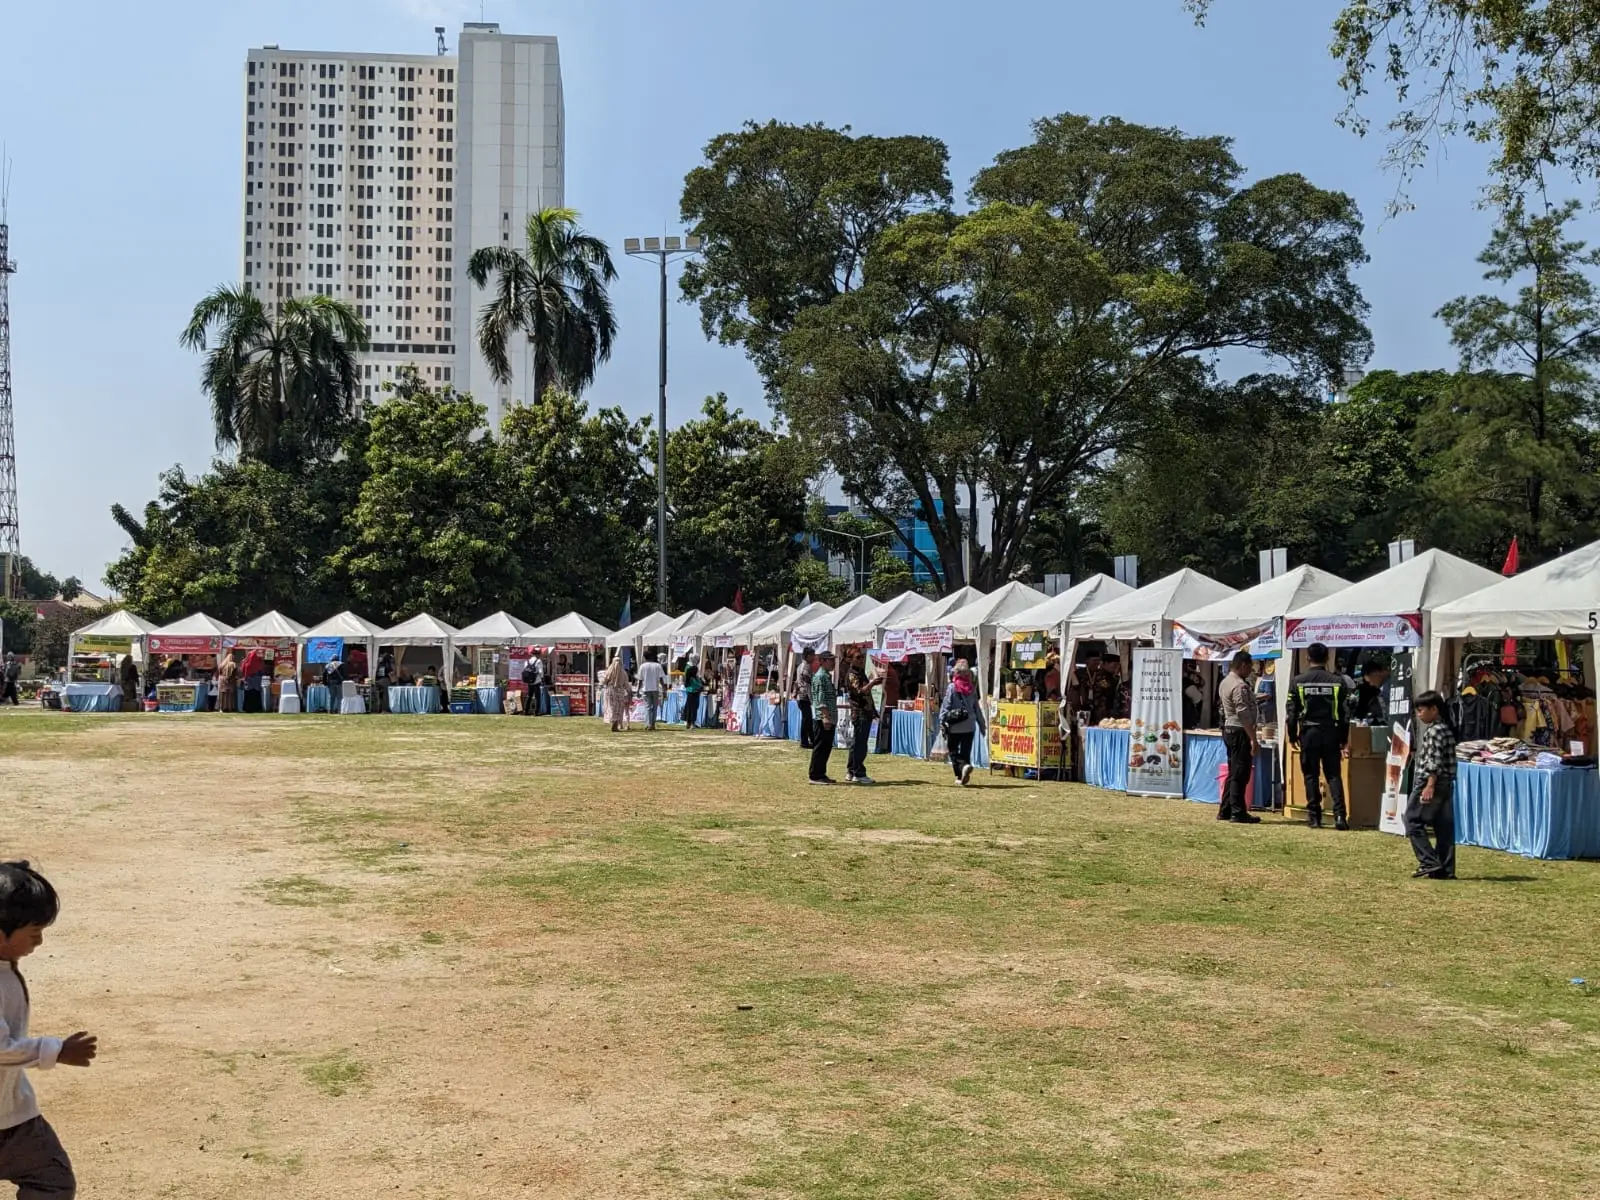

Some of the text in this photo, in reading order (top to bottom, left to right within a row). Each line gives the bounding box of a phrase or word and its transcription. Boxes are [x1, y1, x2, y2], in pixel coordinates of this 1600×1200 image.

[1151, 623, 1158, 636] 8
[1379, 621, 1395, 629] Putih
[1588, 611, 1598, 630] 5
[1007, 713, 1026, 733] LAKSA
[1000, 734, 1014, 753] TOGE
[1013, 735, 1035, 755] GORENG
